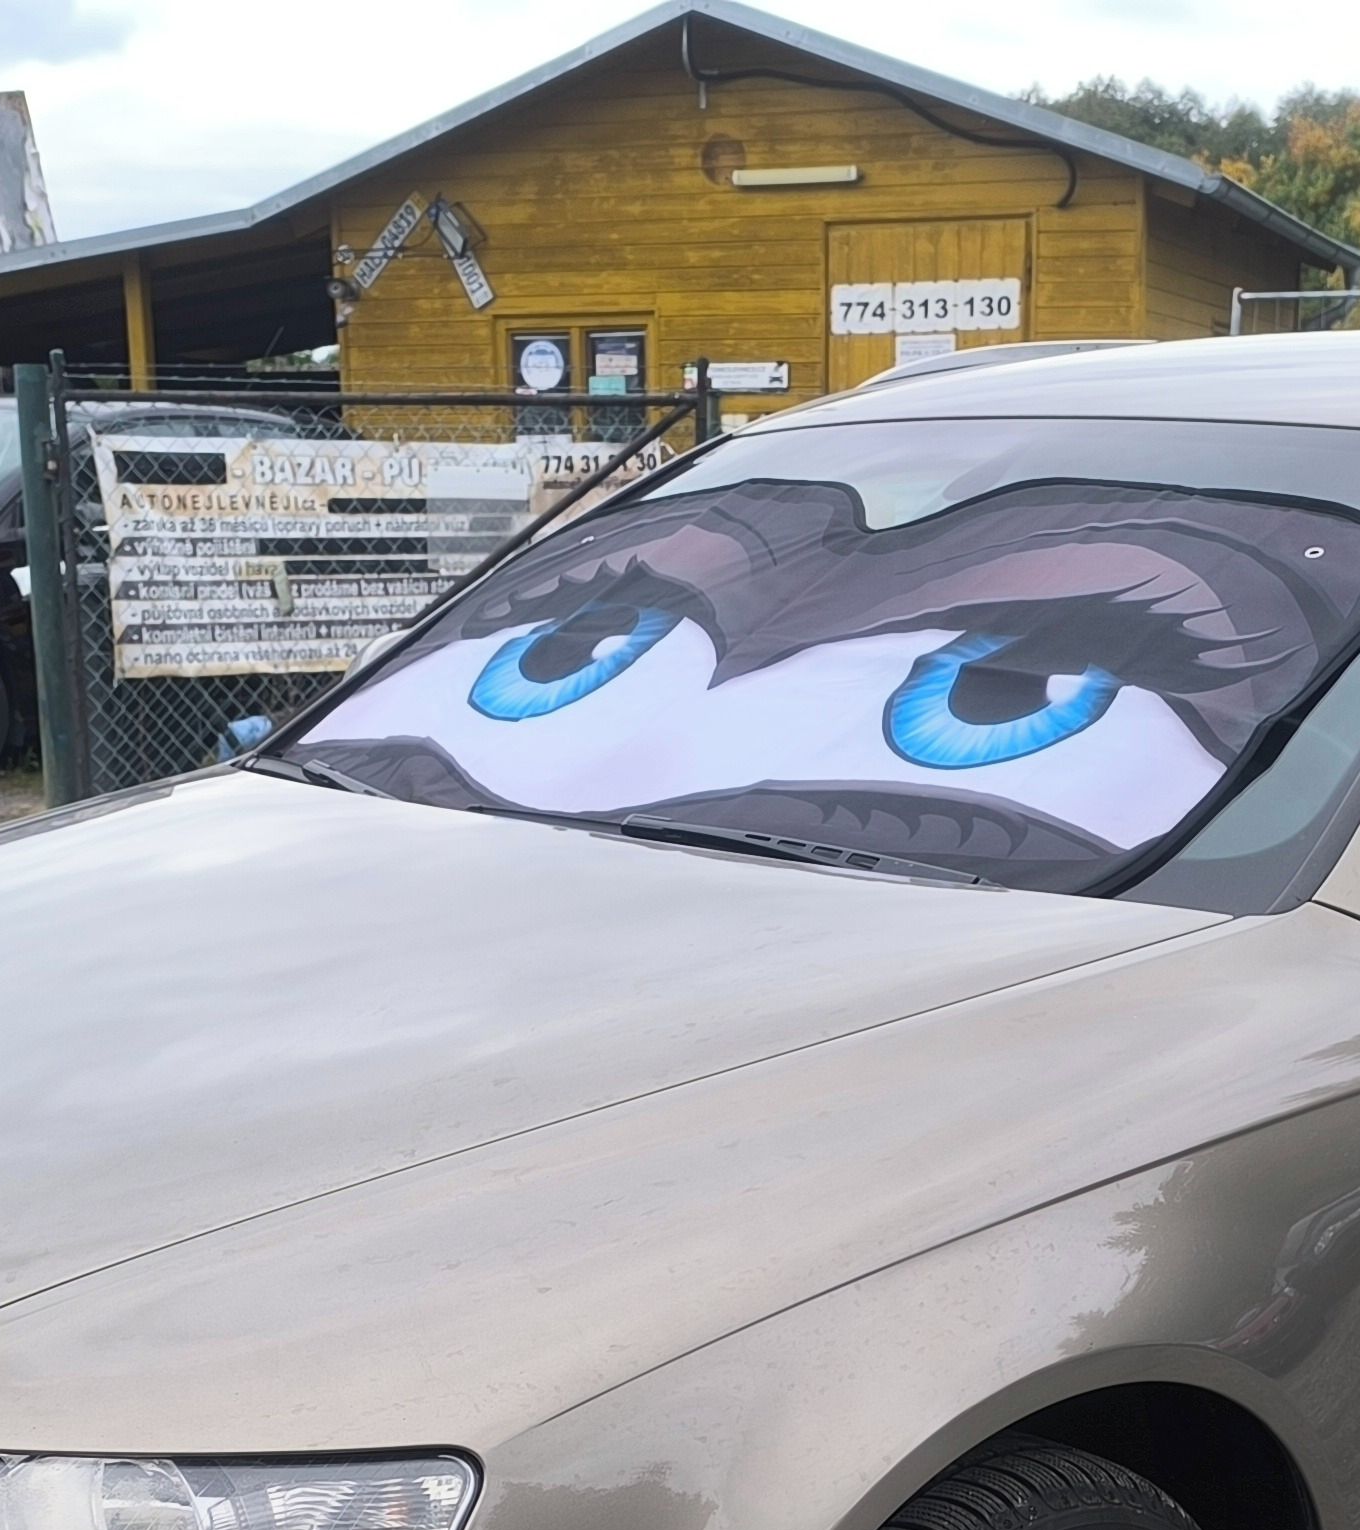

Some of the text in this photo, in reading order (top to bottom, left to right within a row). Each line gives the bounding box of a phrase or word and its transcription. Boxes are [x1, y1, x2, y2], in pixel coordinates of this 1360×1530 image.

[253, 454, 356, 487] BAZAR
[540, 455, 574, 473] 774
[292, 600, 370, 621] odávkových
[143, 652, 184, 664] nano
